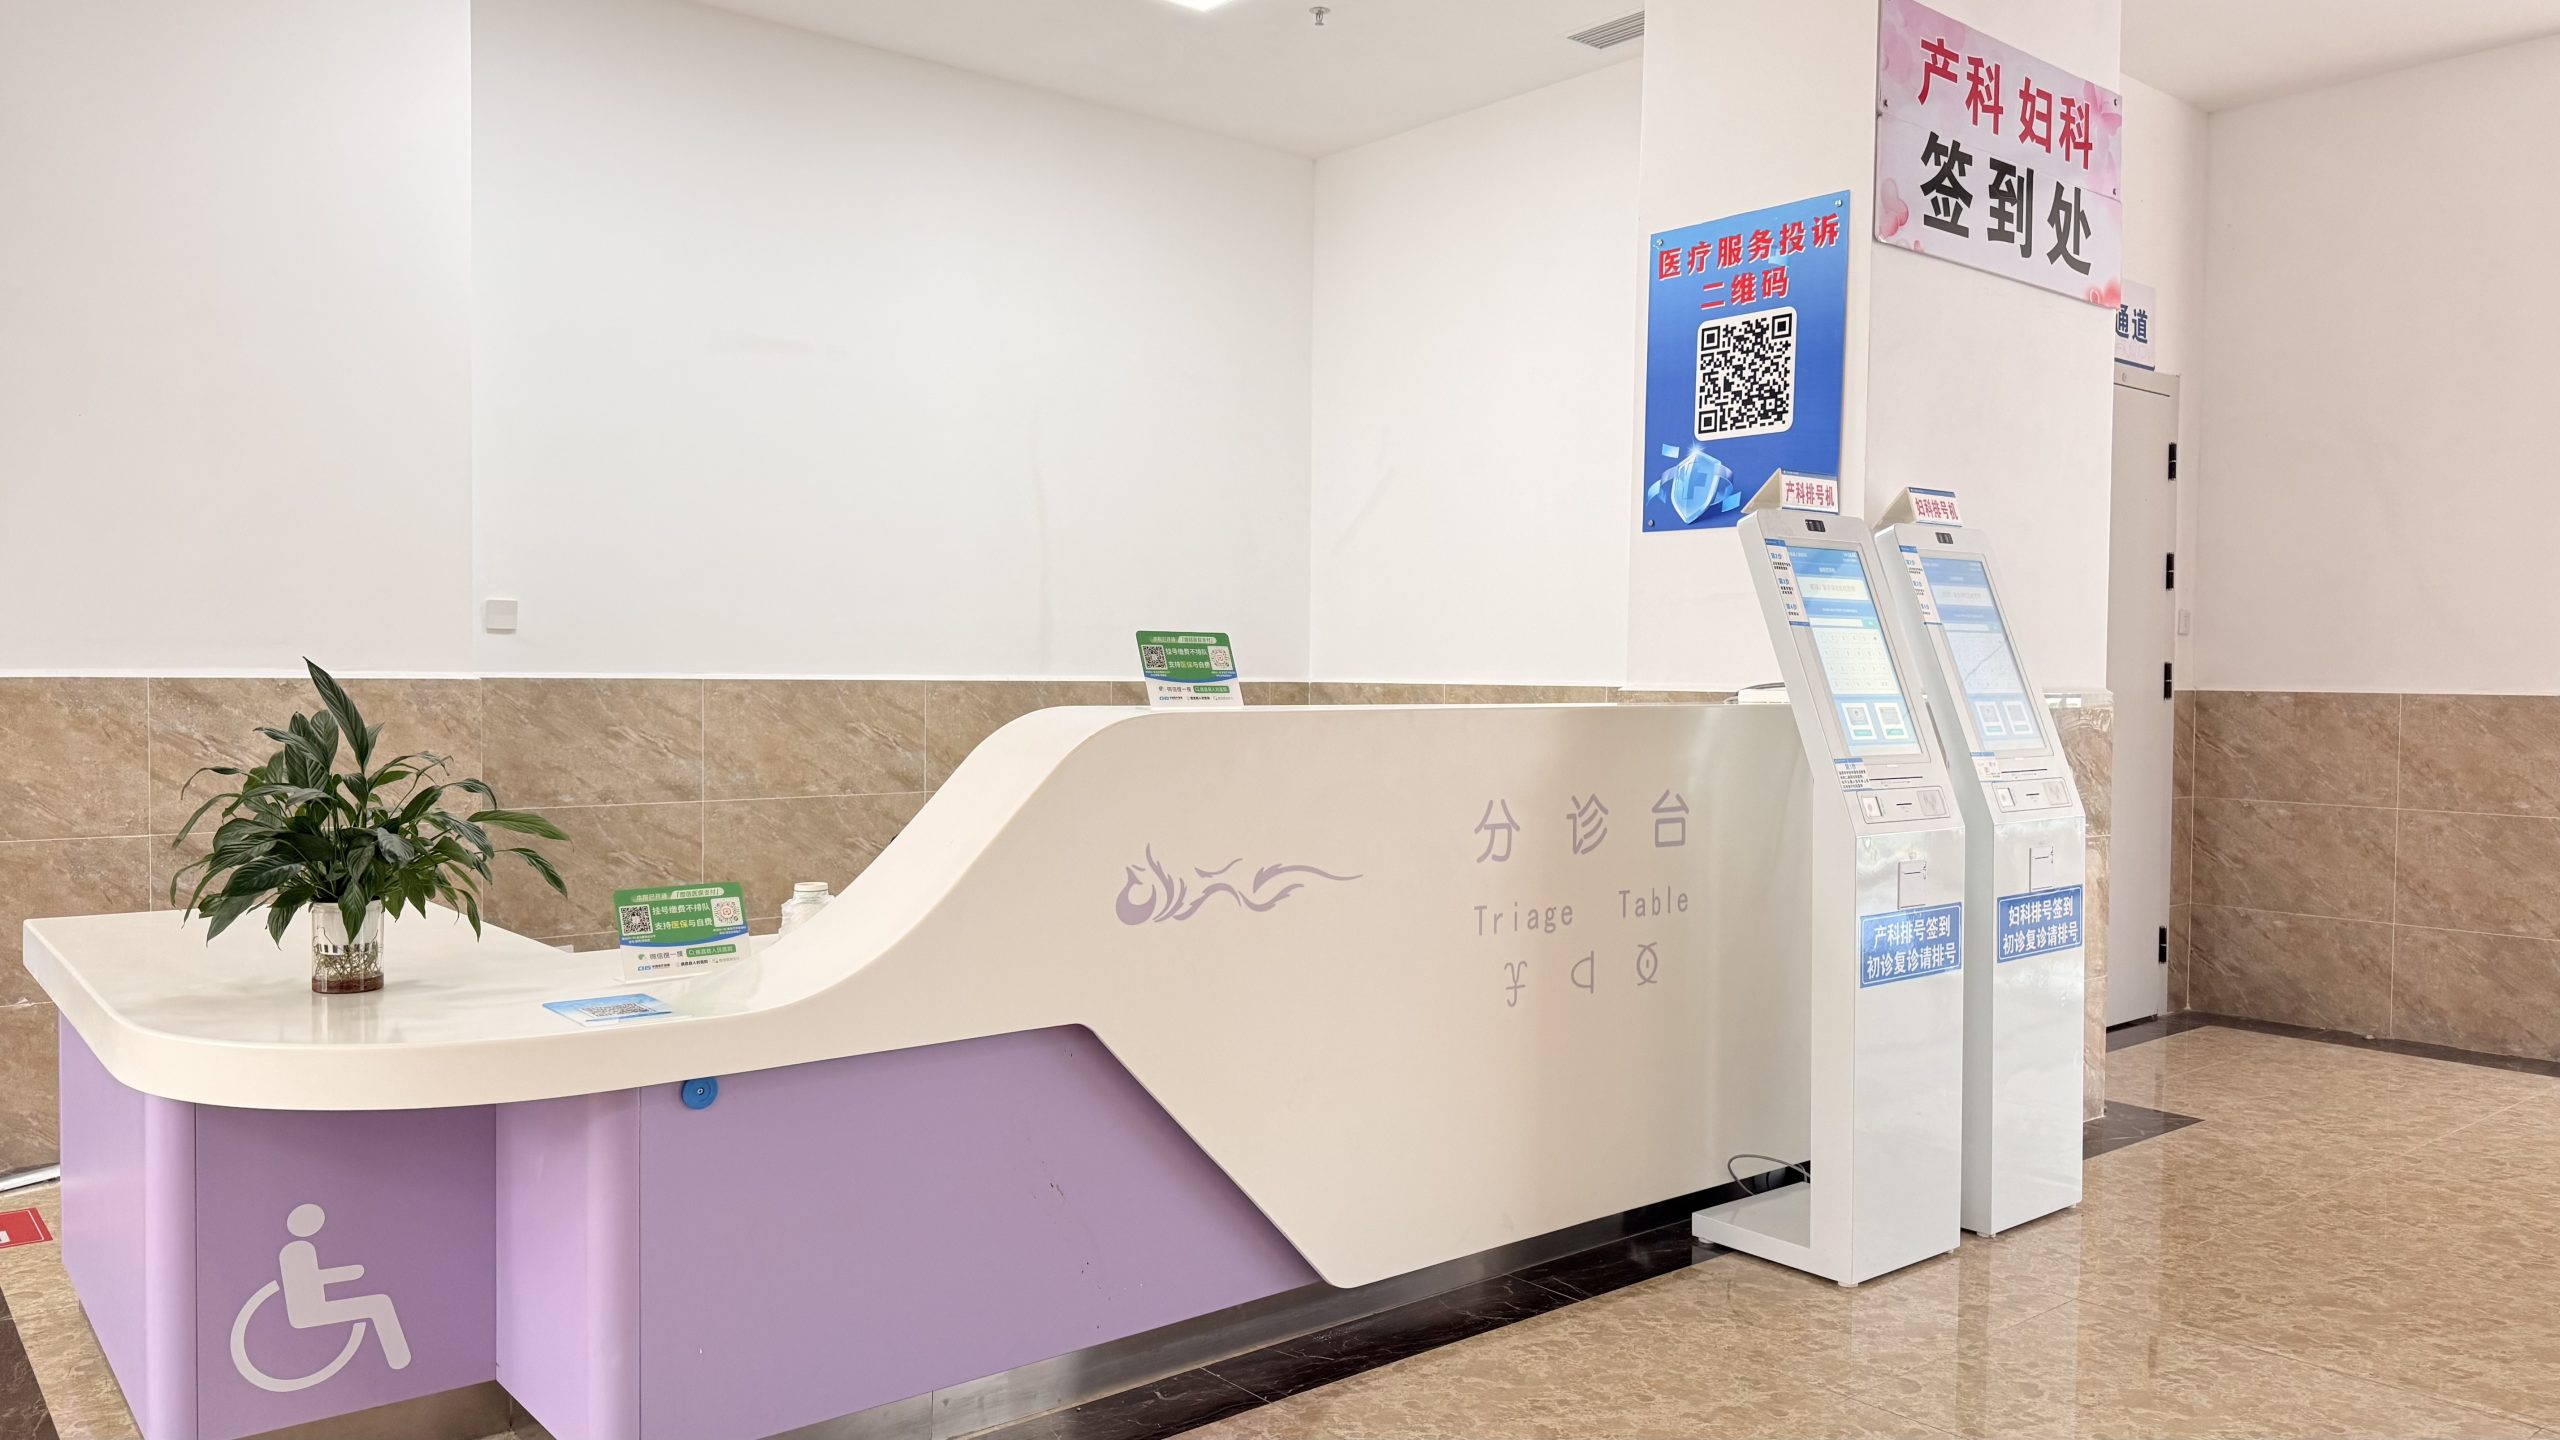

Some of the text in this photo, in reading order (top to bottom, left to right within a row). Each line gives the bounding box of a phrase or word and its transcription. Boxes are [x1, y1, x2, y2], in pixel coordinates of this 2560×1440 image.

[1918, 38, 2093, 171] 产科 妇科
[1920, 130, 2092, 276] 签到处
[1658, 213, 1841, 281] 医疗服务投诉
[1700, 265, 1790, 310] 二维码
[1785, 480, 1835, 507] 产科排号机
[1915, 497, 1959, 521] 妇科排号机
[1474, 789, 1689, 863] 分诊台
[652, 903, 711, 916] 挂号缴费不排队
[654, 917, 713, 931] 支持医保与自费
[1474, 886, 1688, 936] Triage Table
[2008, 894, 2074, 928] 妇科排号签到
[1873, 914, 1951, 949] 产科排号签到
[2002, 920, 2079, 955] 初诊复诊请排号
[1866, 941, 1957, 982] 初诊复诊请排号
